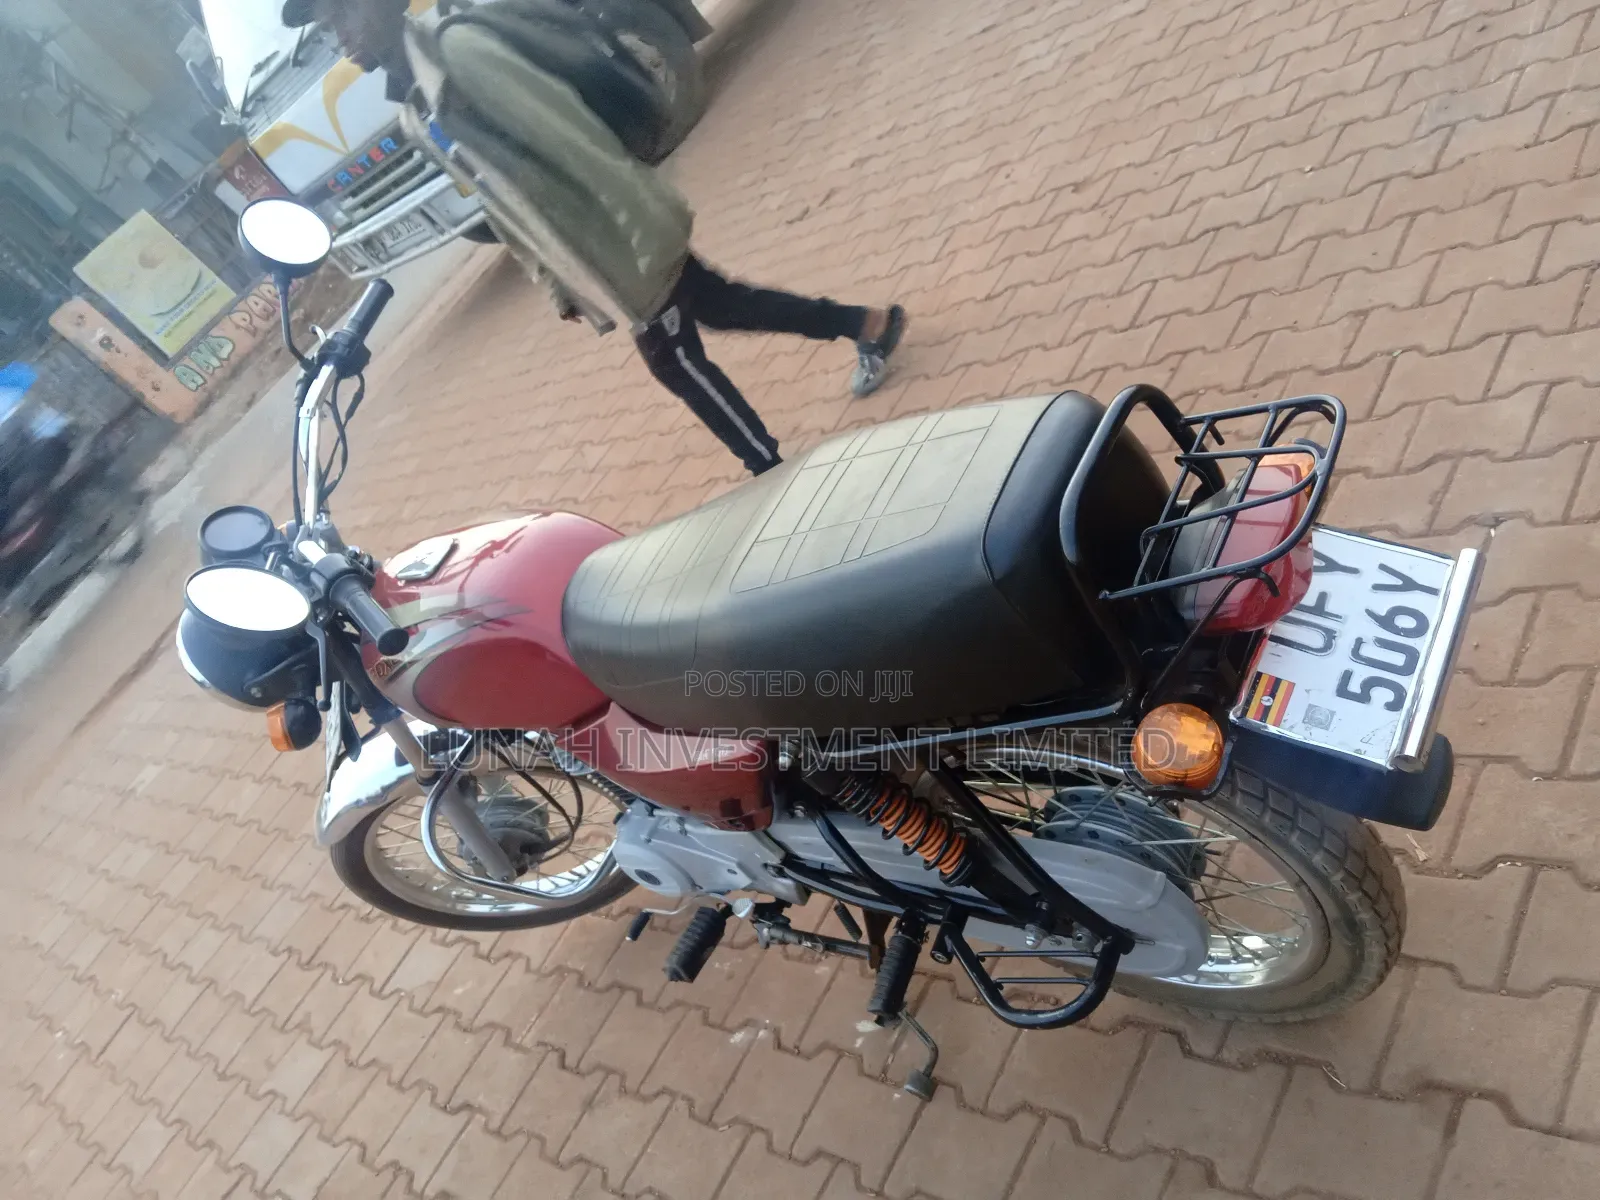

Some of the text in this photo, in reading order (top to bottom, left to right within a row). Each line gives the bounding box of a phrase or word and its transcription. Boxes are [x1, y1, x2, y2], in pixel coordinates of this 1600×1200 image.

[327, 137, 398, 193] CANTER
[173, 335, 235, 391] AND
[1268, 549, 1360, 656] UFY
[1336, 563, 1440, 712] 506Y
